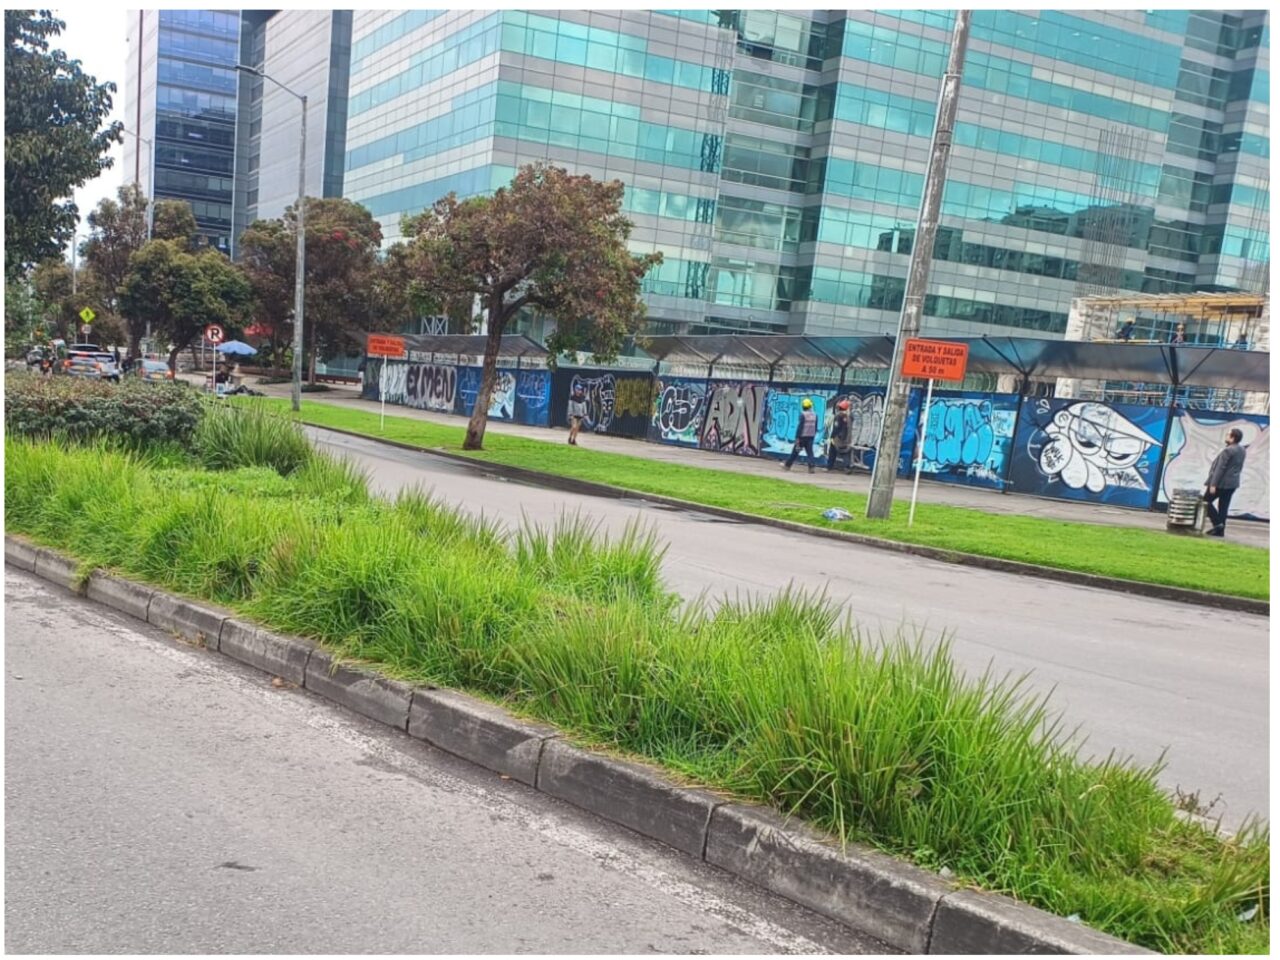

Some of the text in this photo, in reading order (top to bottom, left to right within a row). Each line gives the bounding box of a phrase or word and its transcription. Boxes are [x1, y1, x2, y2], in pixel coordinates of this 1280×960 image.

[908, 343, 964, 357] ENTRADA Y SALIDA
[912, 354, 921, 362] DE
